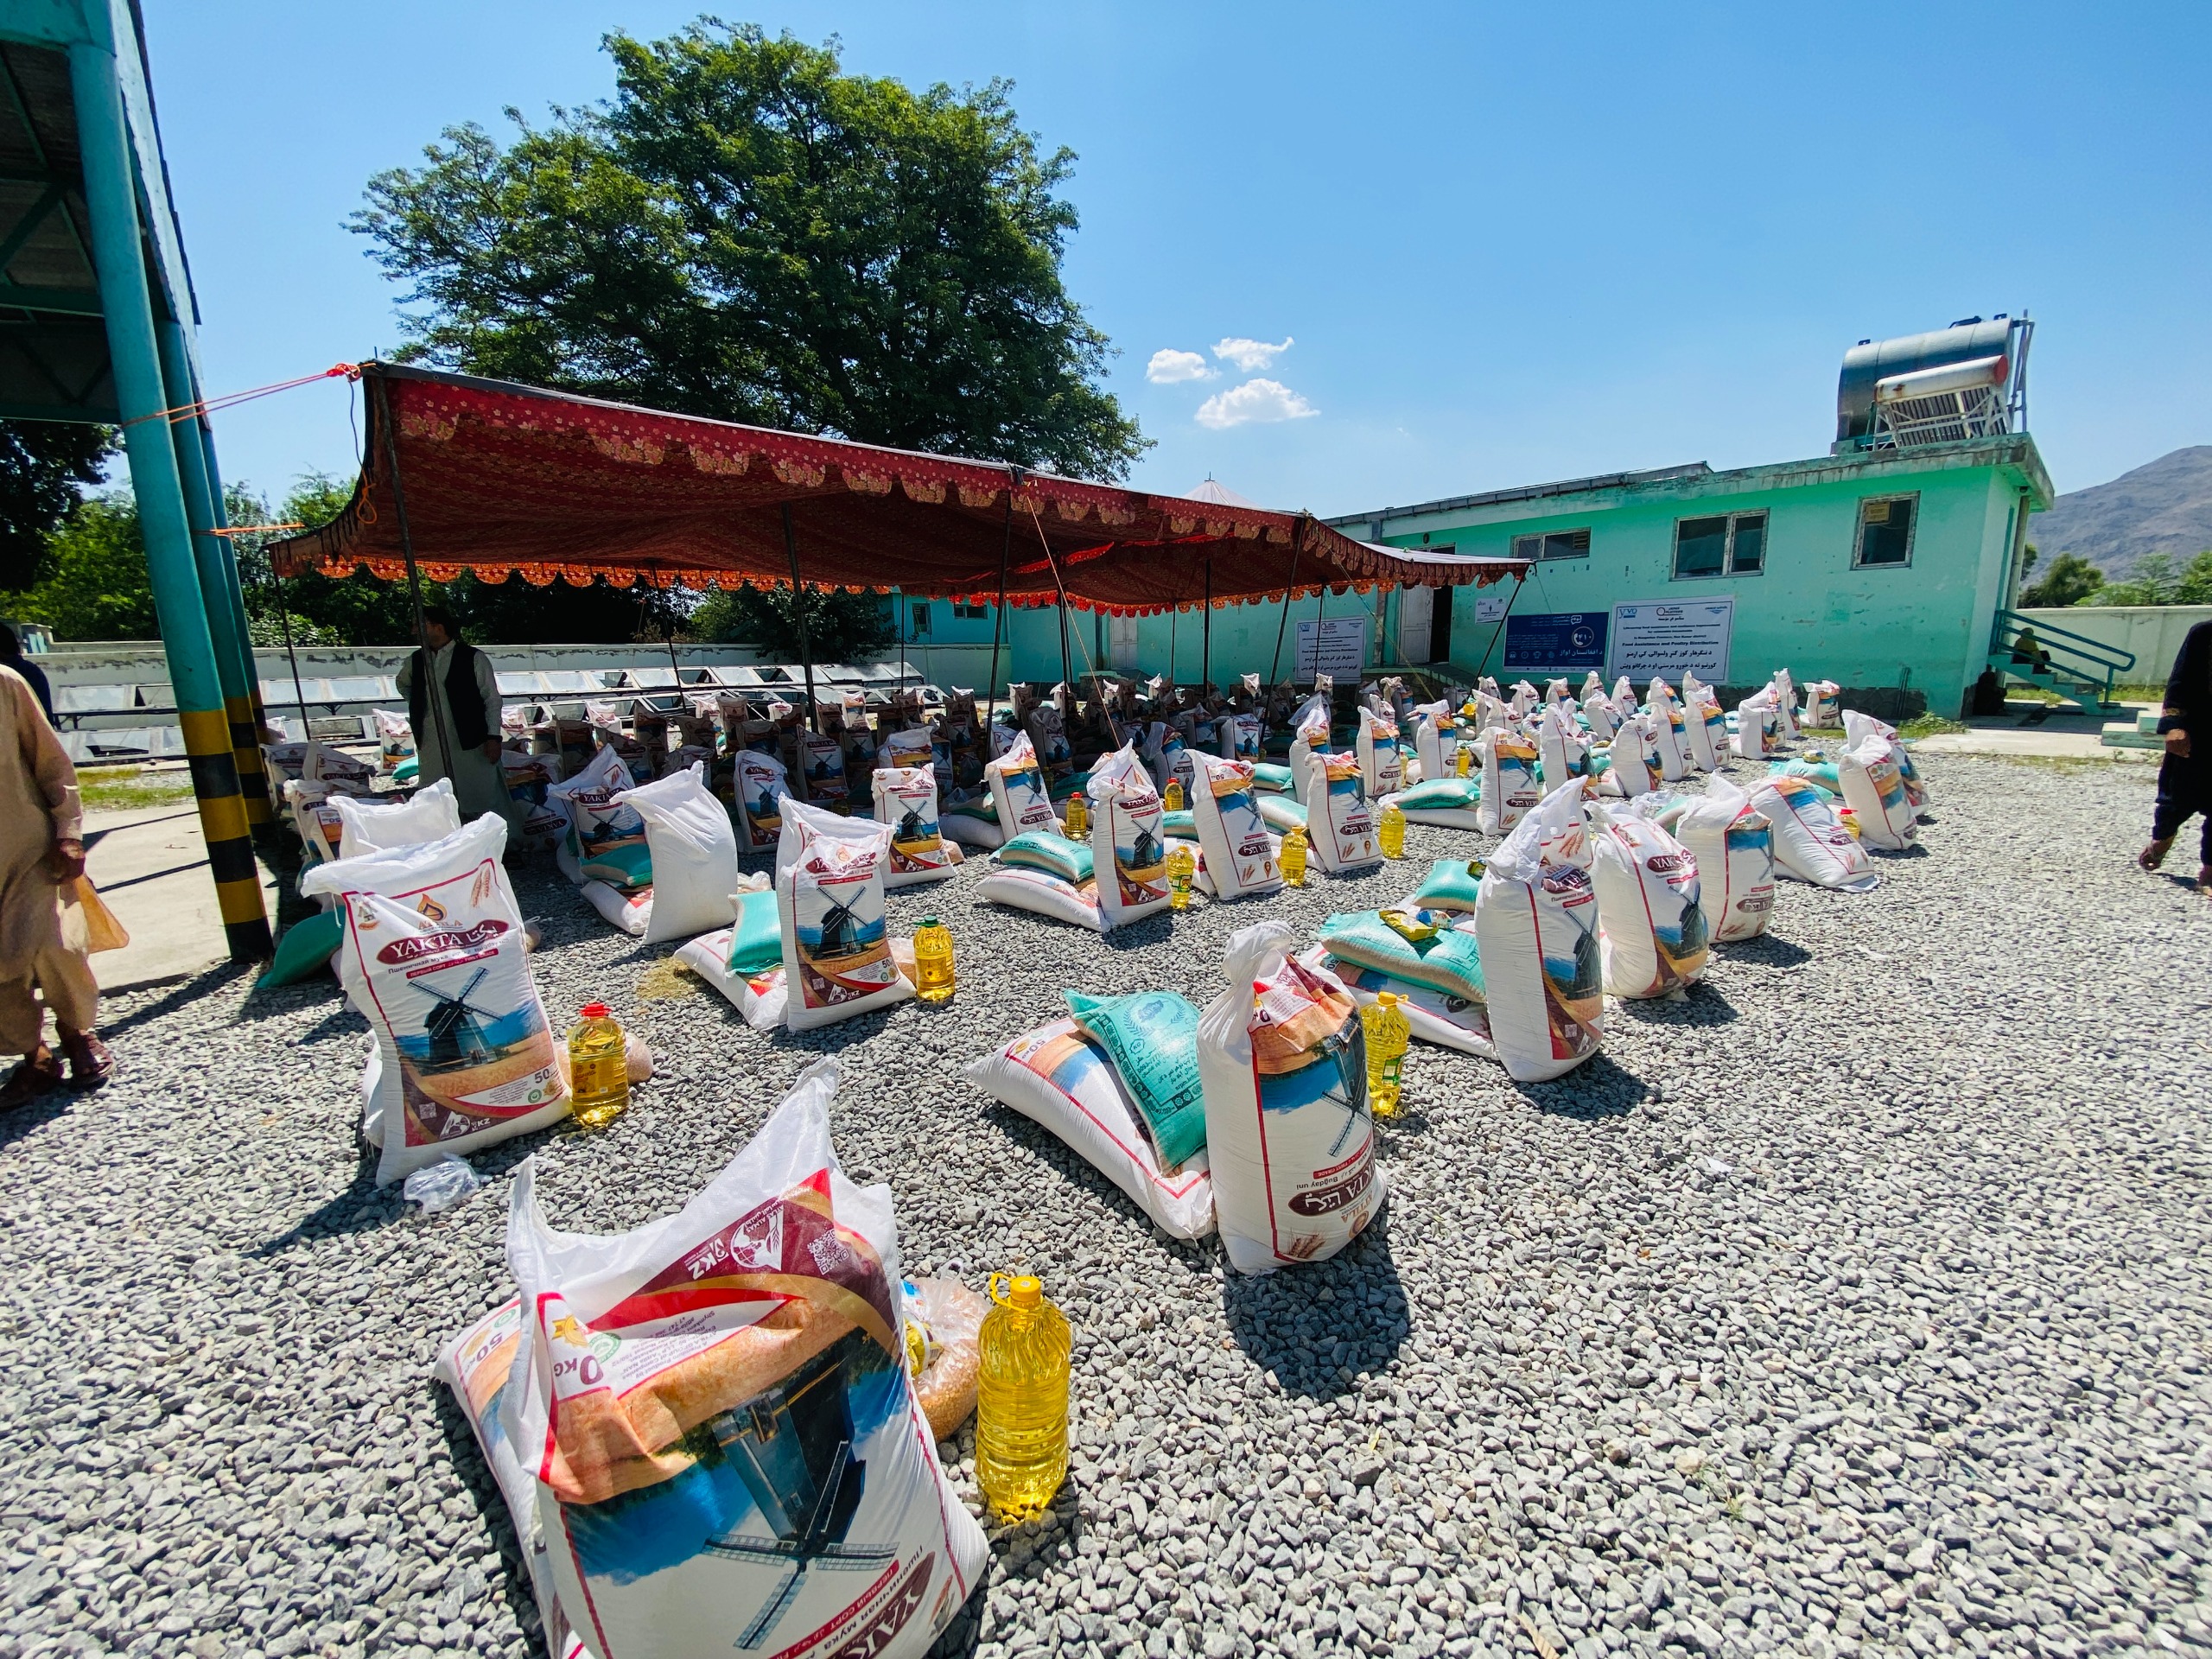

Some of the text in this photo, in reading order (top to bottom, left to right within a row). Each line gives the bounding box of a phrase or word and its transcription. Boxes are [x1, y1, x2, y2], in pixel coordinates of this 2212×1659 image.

[391, 933, 462, 958] YAKTA
[1305, 1192, 1341, 1211] یکتا
[1341, 1191, 1372, 1224] ATTILA
[746, 1205, 784, 1234] ATLAS ALMAS
[688, 1252, 718, 1281] KZ
[856, 1568, 893, 1611] ПЕРВЫЙ
[861, 1544, 924, 1622] Пшеничная
[830, 1607, 856, 1631] СОРТ
[823, 1620, 857, 1651] мука
